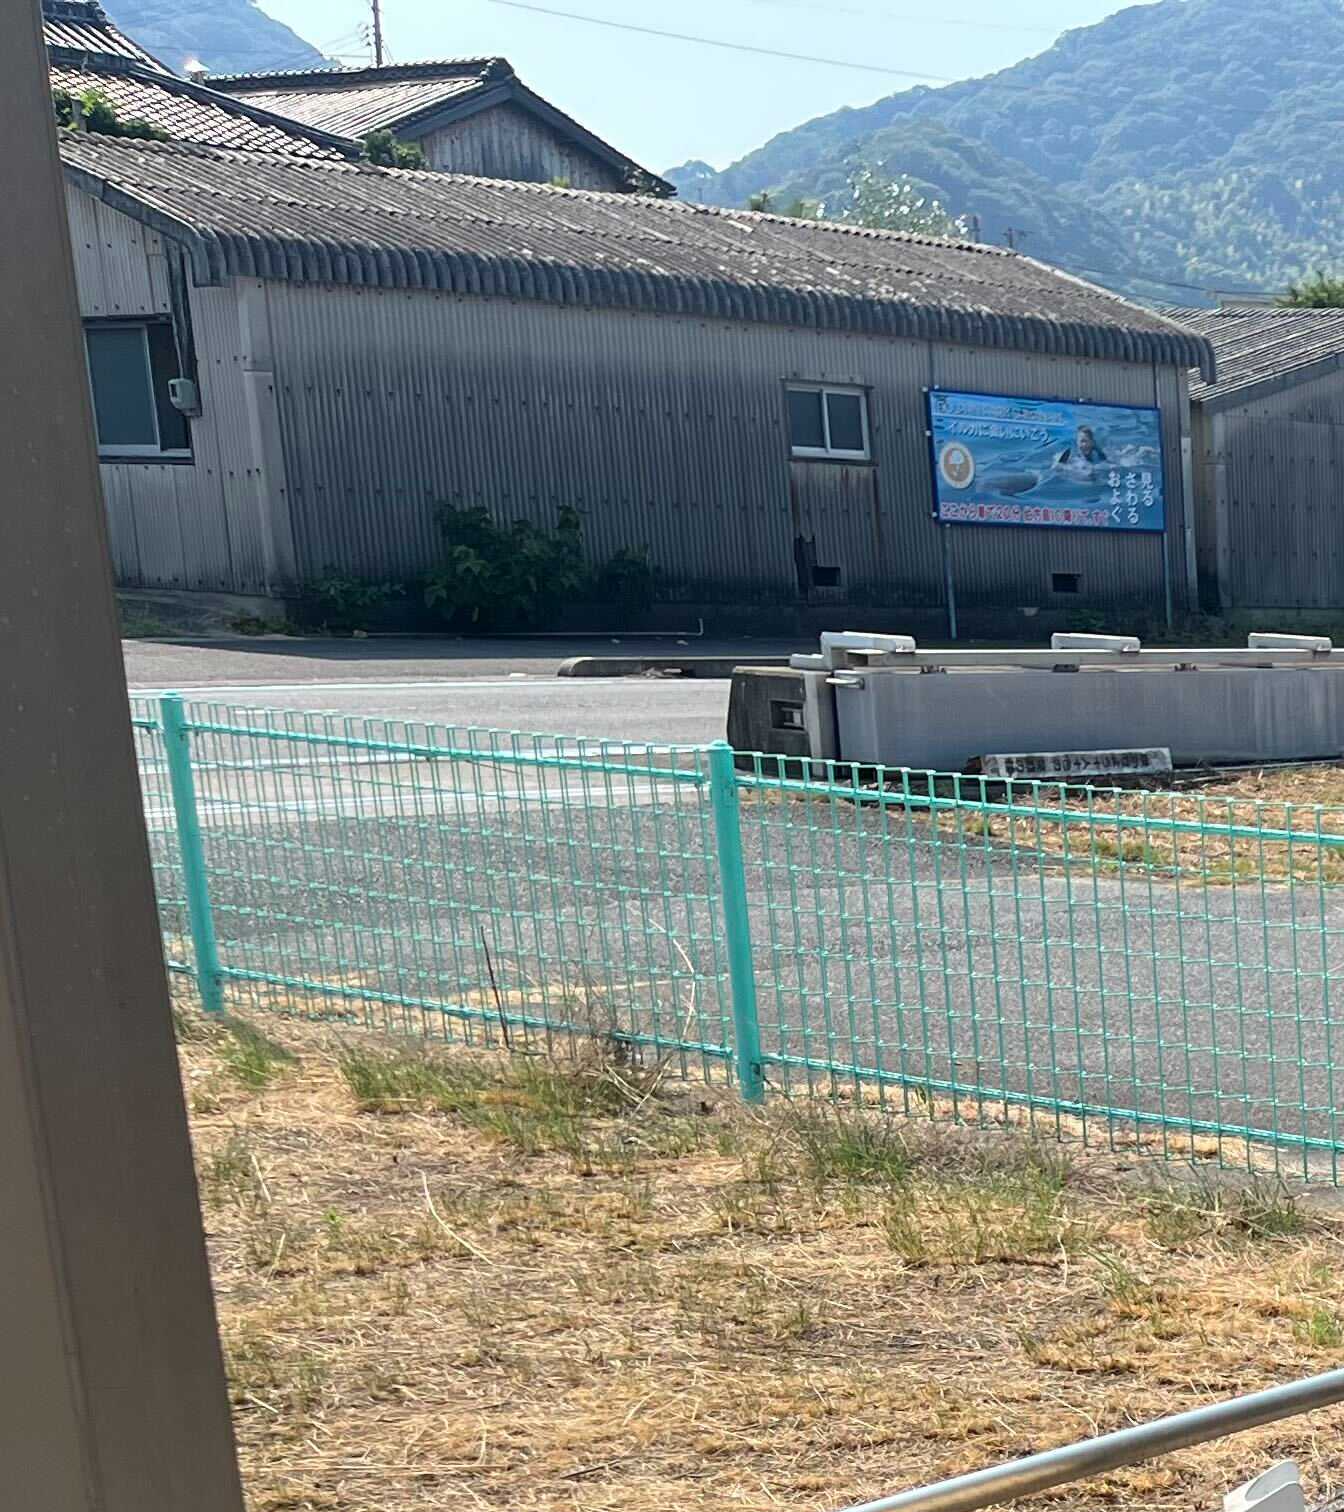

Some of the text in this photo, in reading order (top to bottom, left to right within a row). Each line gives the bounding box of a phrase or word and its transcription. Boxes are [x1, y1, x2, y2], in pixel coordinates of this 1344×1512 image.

[1107, 471, 1122, 523] およぐ
[1125, 472, 1140, 525] さわる
[1140, 471, 1155, 507] 見る
